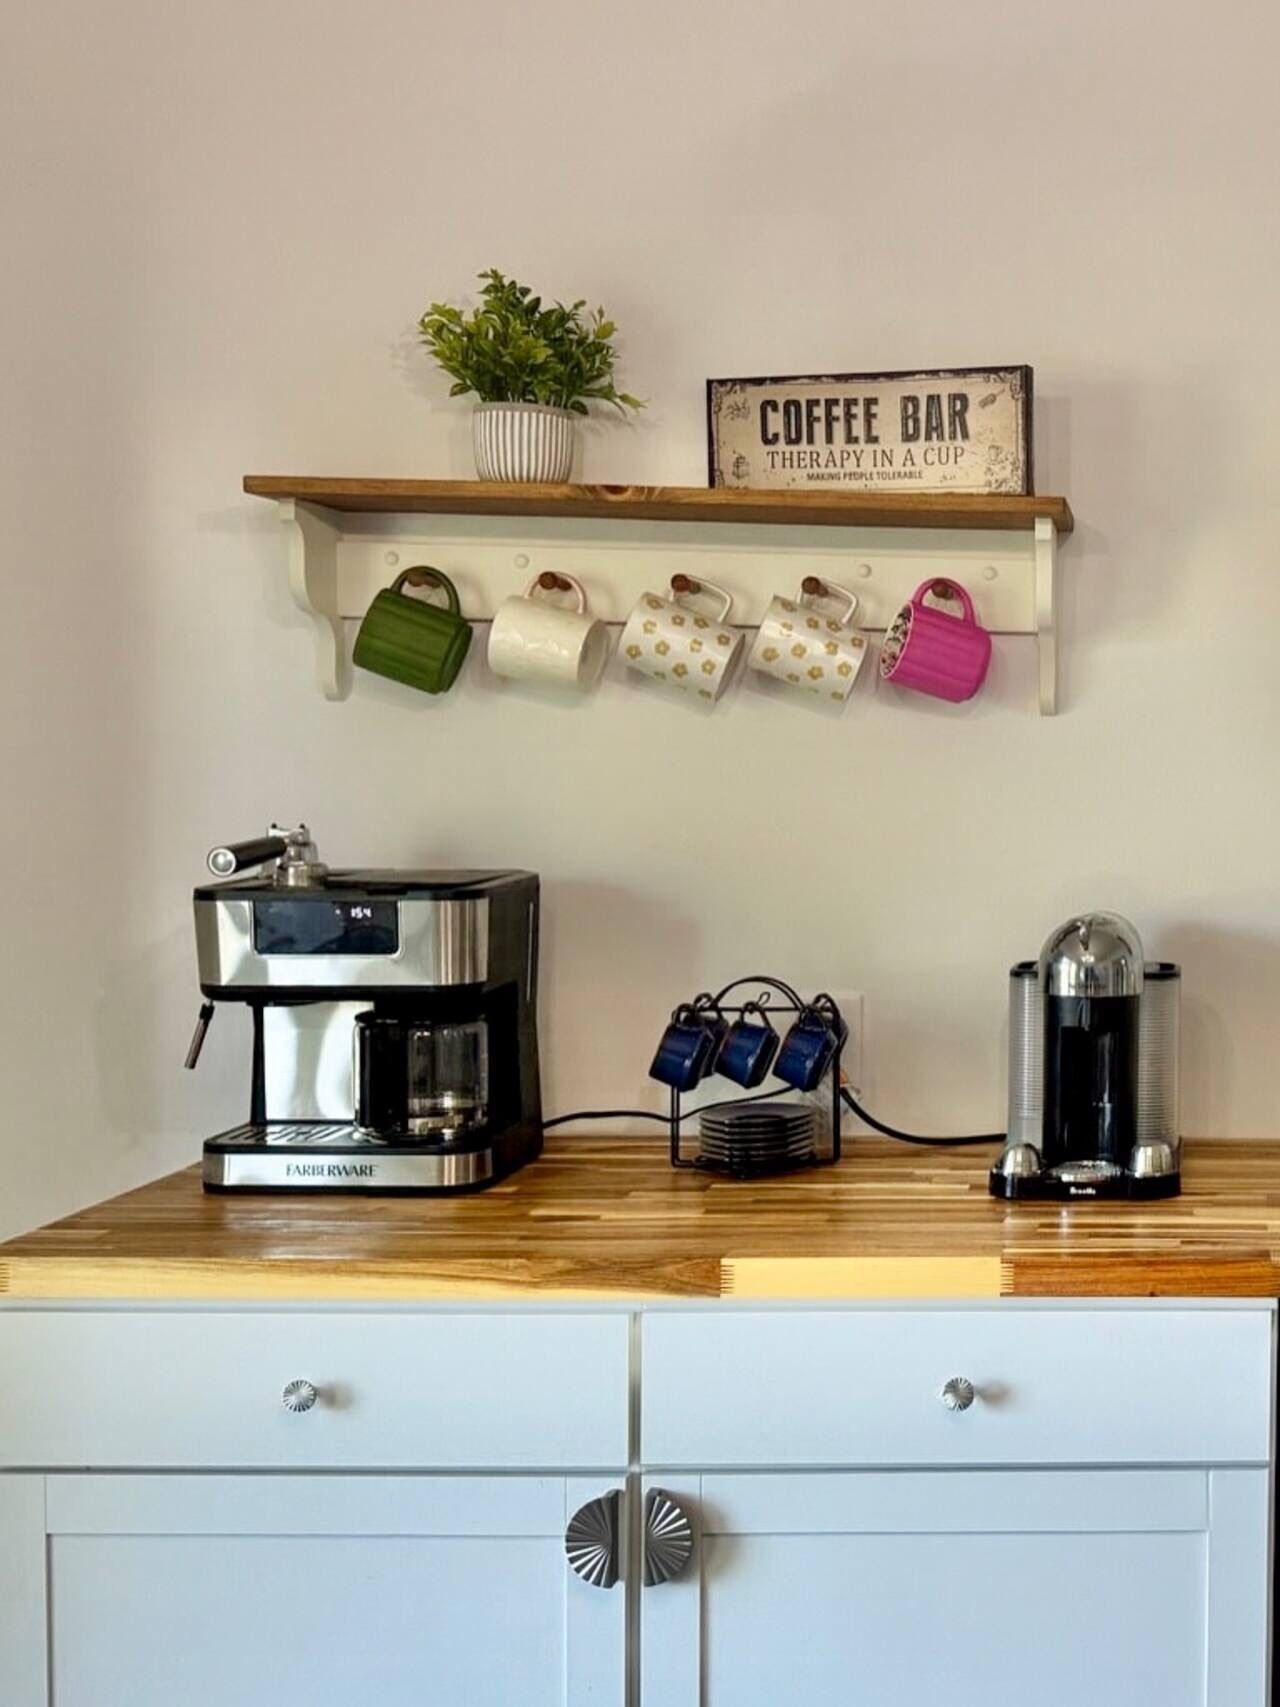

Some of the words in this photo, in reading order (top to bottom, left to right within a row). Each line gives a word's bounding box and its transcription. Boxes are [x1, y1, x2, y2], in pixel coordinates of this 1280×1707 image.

[760, 397, 880, 446] COFFEE
[900, 392, 970, 443] BAR
[766, 449, 865, 470] THERAPY
[872, 448, 894, 468] IN
[902, 447, 916, 467] A
[923, 445, 965, 467] CUP
[806, 471, 841, 481] MAKING
[842, 470, 874, 481] PEOPLE
[875, 469, 923, 480] TOLERABLE
[285, 1164, 377, 1177] FARBERWARE
